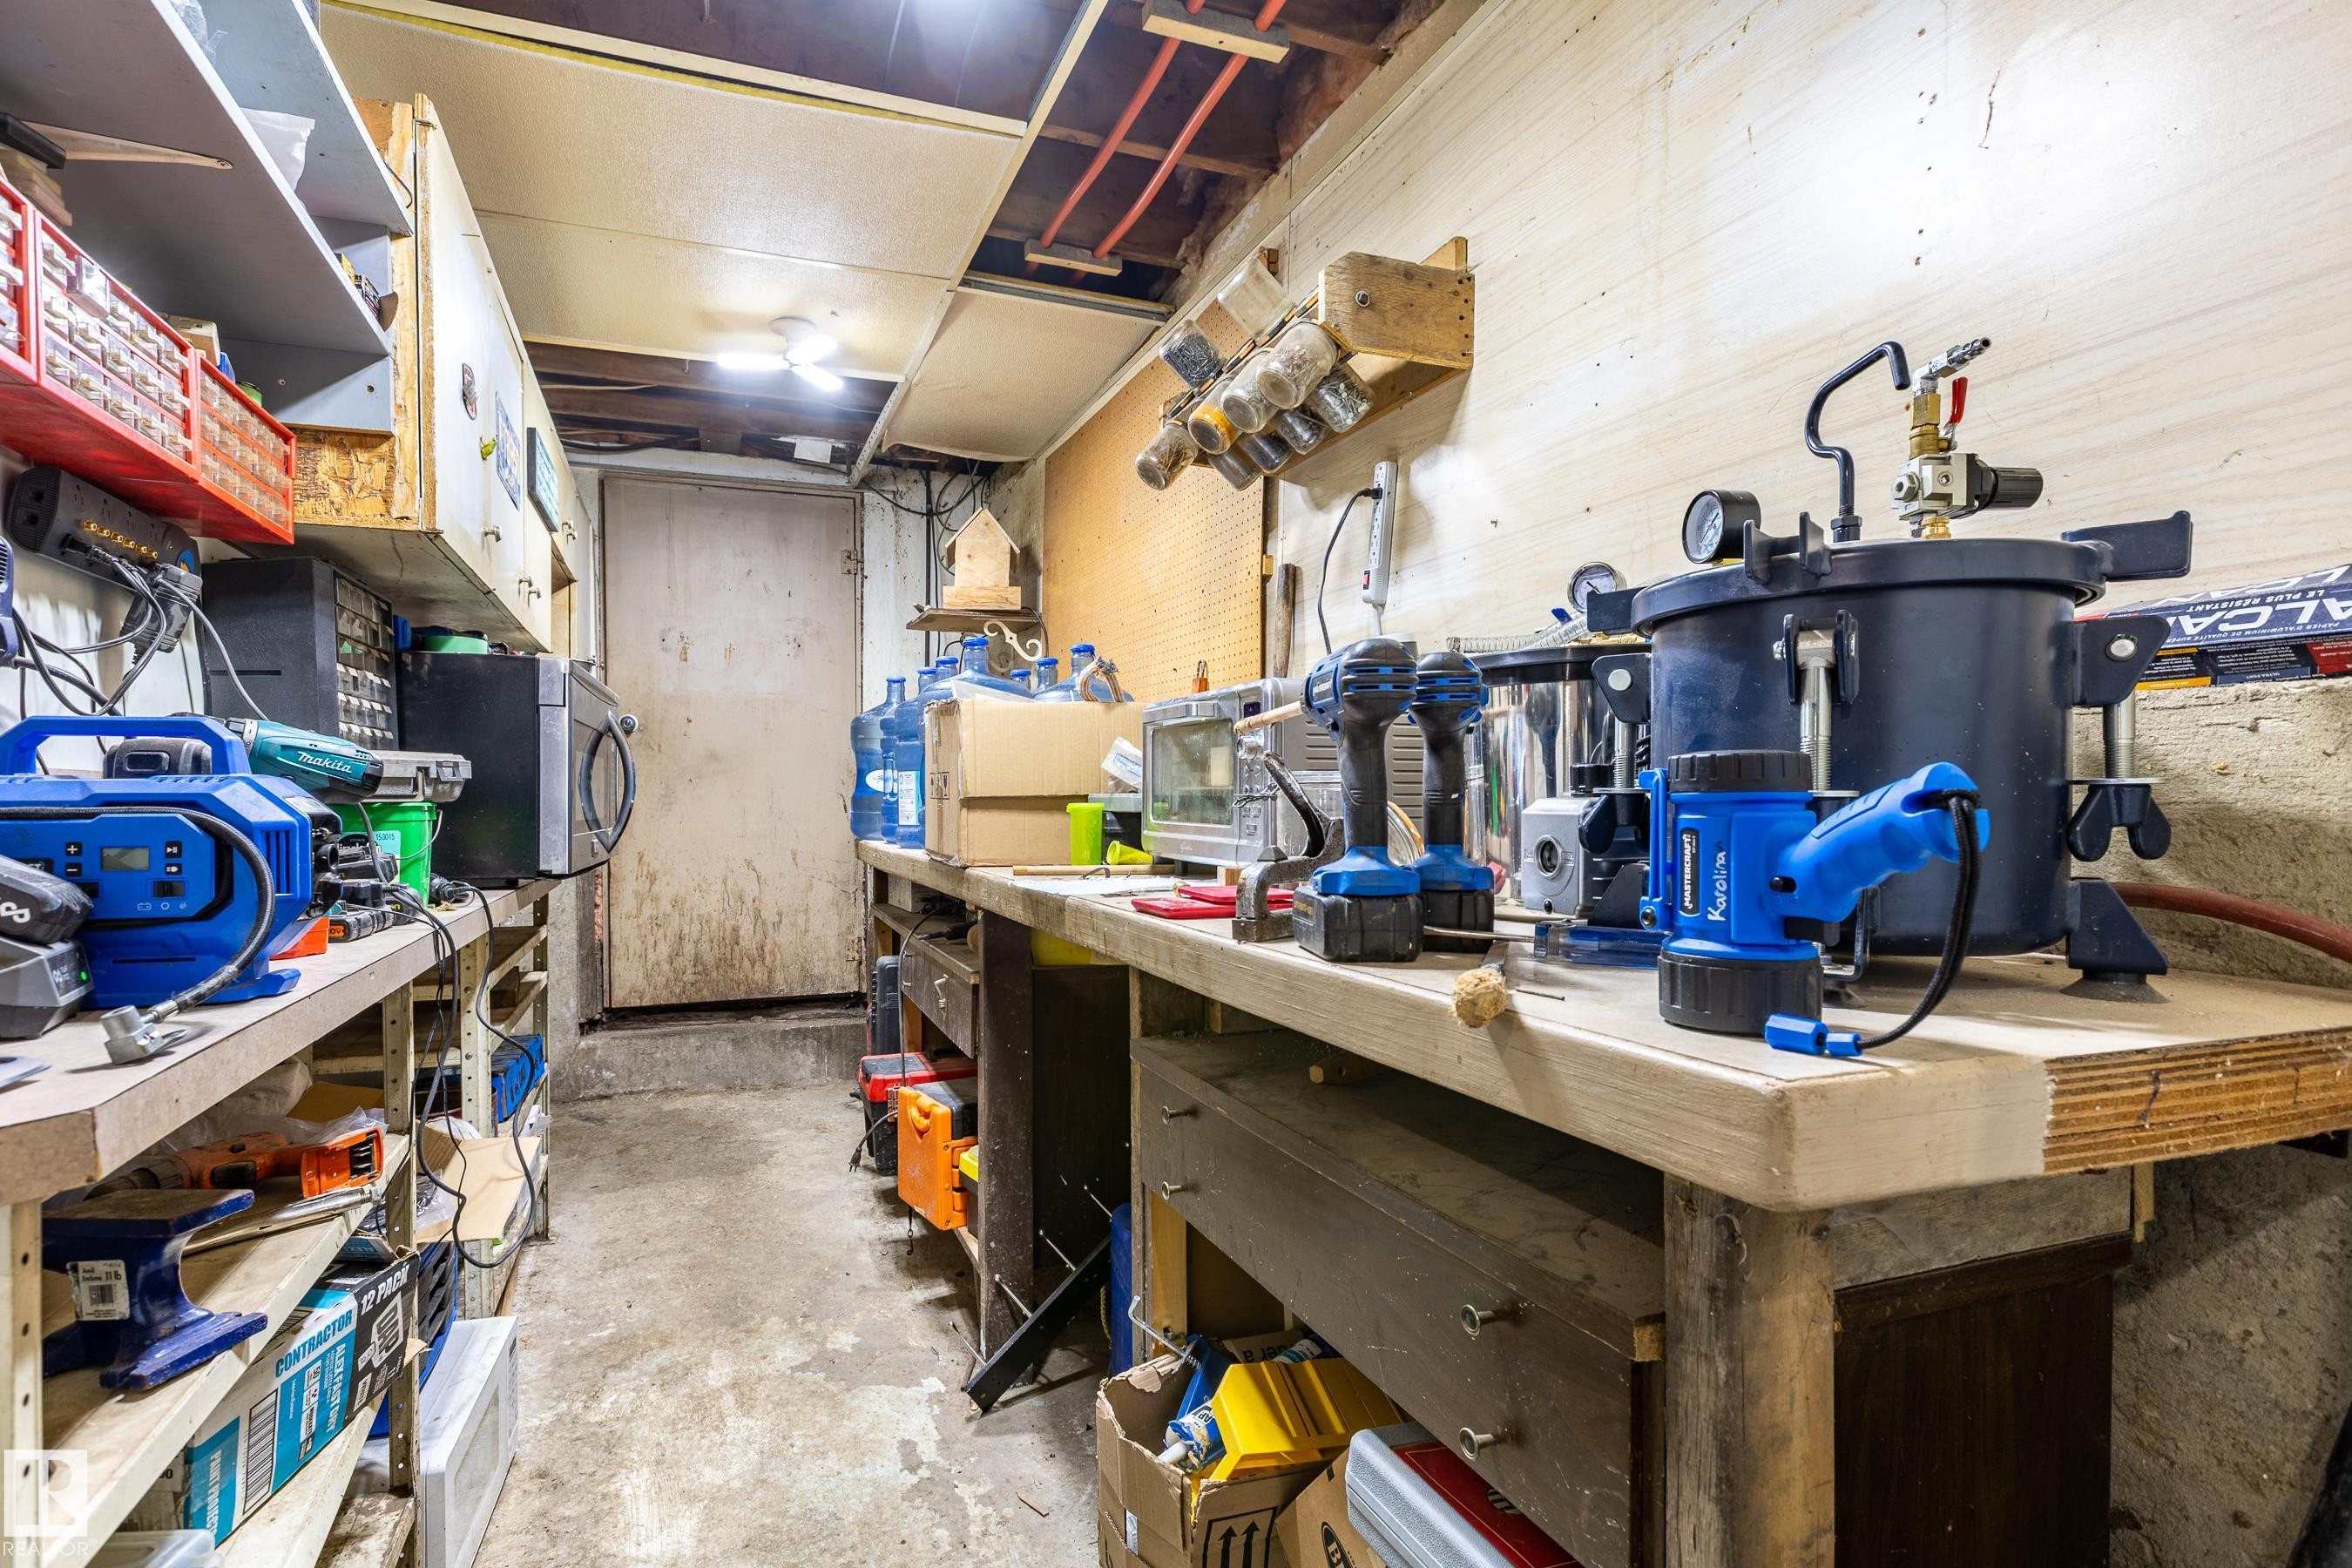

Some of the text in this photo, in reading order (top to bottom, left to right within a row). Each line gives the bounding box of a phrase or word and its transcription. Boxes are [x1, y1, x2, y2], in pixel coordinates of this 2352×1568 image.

[2186, 598, 2259, 612] RÉSISTANT
[2265, 591, 2301, 602] PLUS
[2166, 598, 2352, 636] ALCA
[2244, 625, 2302, 635] D'ALUMINIUM
[2194, 632, 2227, 641] QUALITÉ
[1682, 833, 1693, 909] MASTERCRAFT
[105, 1271, 112, 1281] 11
[114, 1270, 122, 1281] lb
[361, 1263, 410, 1315] 12 PACK
[275, 1309, 353, 1378] CONTRACTOR
[376, 1302, 399, 1355] DAP
[313, 1366, 321, 1378] 50
[326, 1343, 346, 1433] ALEX FAST DRY
[209, 1449, 222, 1486] PAINT
